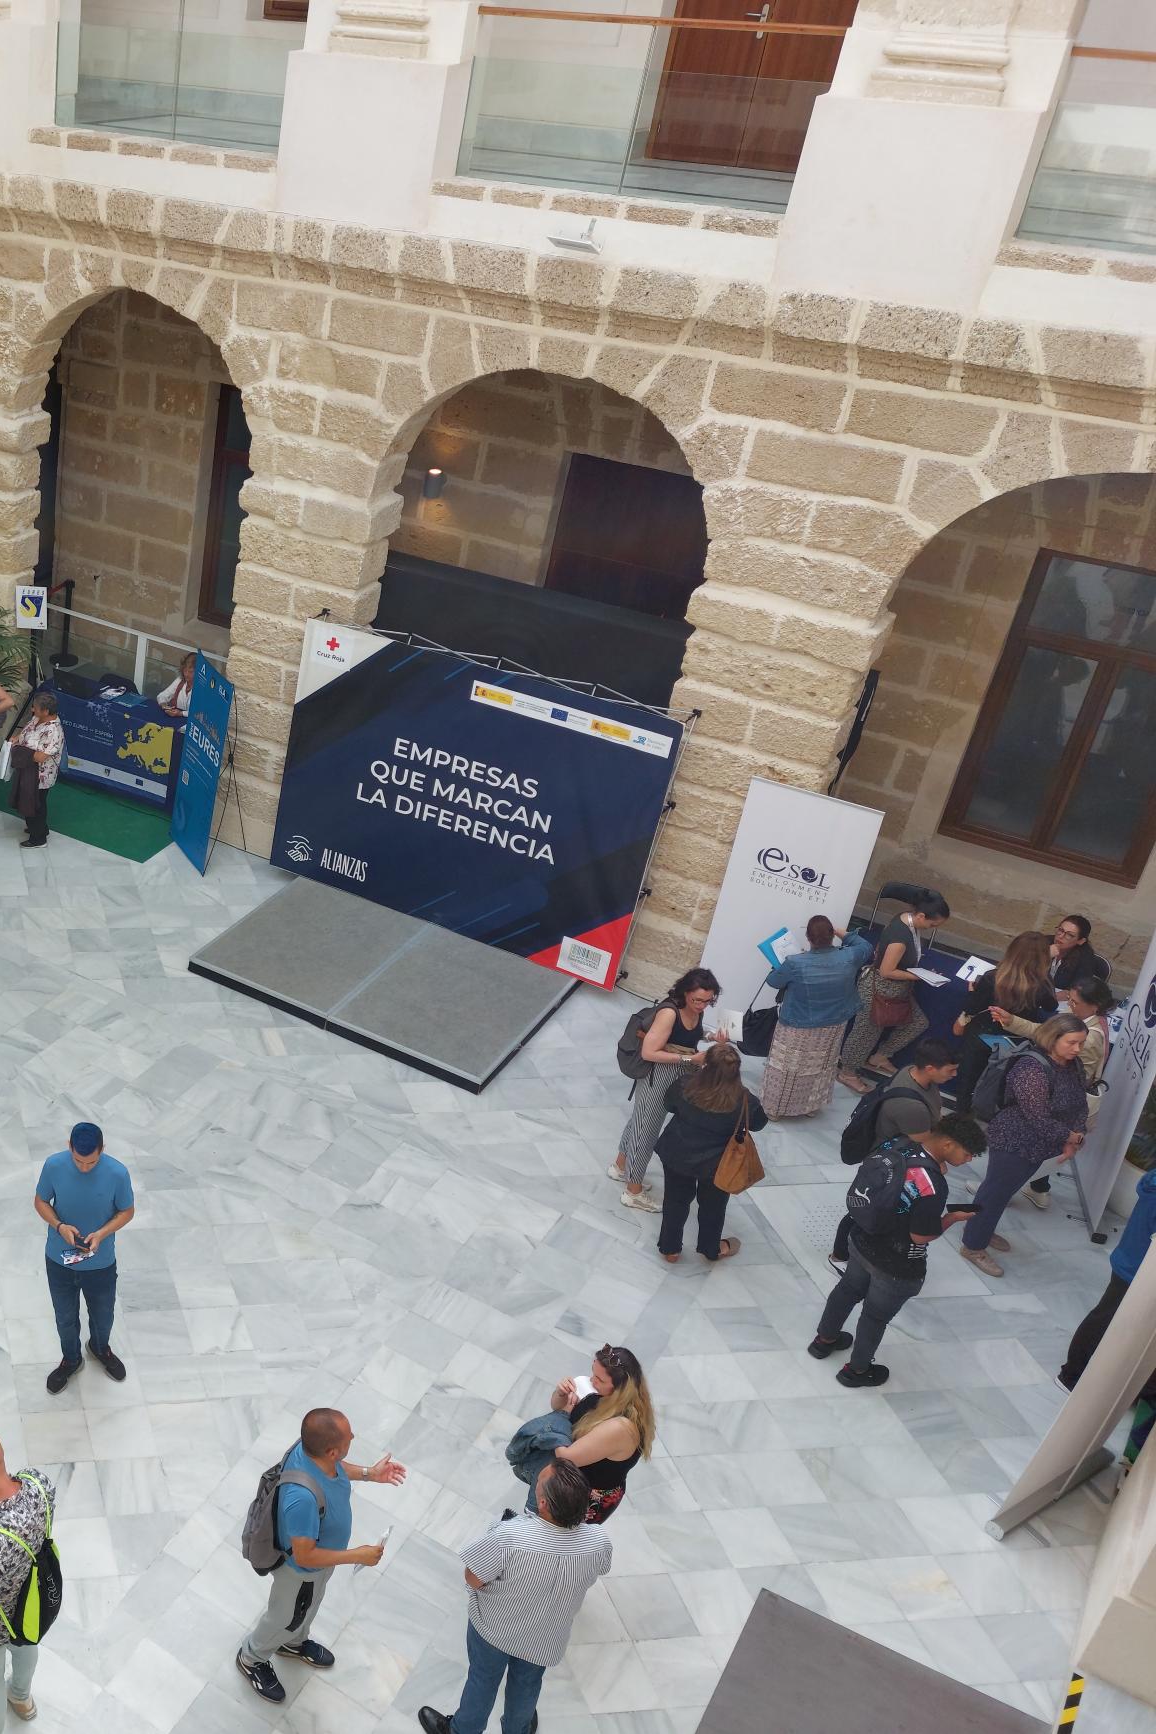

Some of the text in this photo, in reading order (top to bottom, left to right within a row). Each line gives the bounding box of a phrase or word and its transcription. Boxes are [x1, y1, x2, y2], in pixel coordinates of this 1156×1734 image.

[316, 650, 345, 663] Cruz Roja
[192, 725, 220, 768] EURES
[394, 737, 539, 799] EMPRESAS
[370, 760, 552, 833] QUE MARCAN
[356, 782, 555, 865] LA DIFERENCIA
[320, 848, 368, 882] ALIANZAS
[752, 870, 827, 898] EMPLOYMENT
[750, 876, 803, 898] SOLUTIONS
